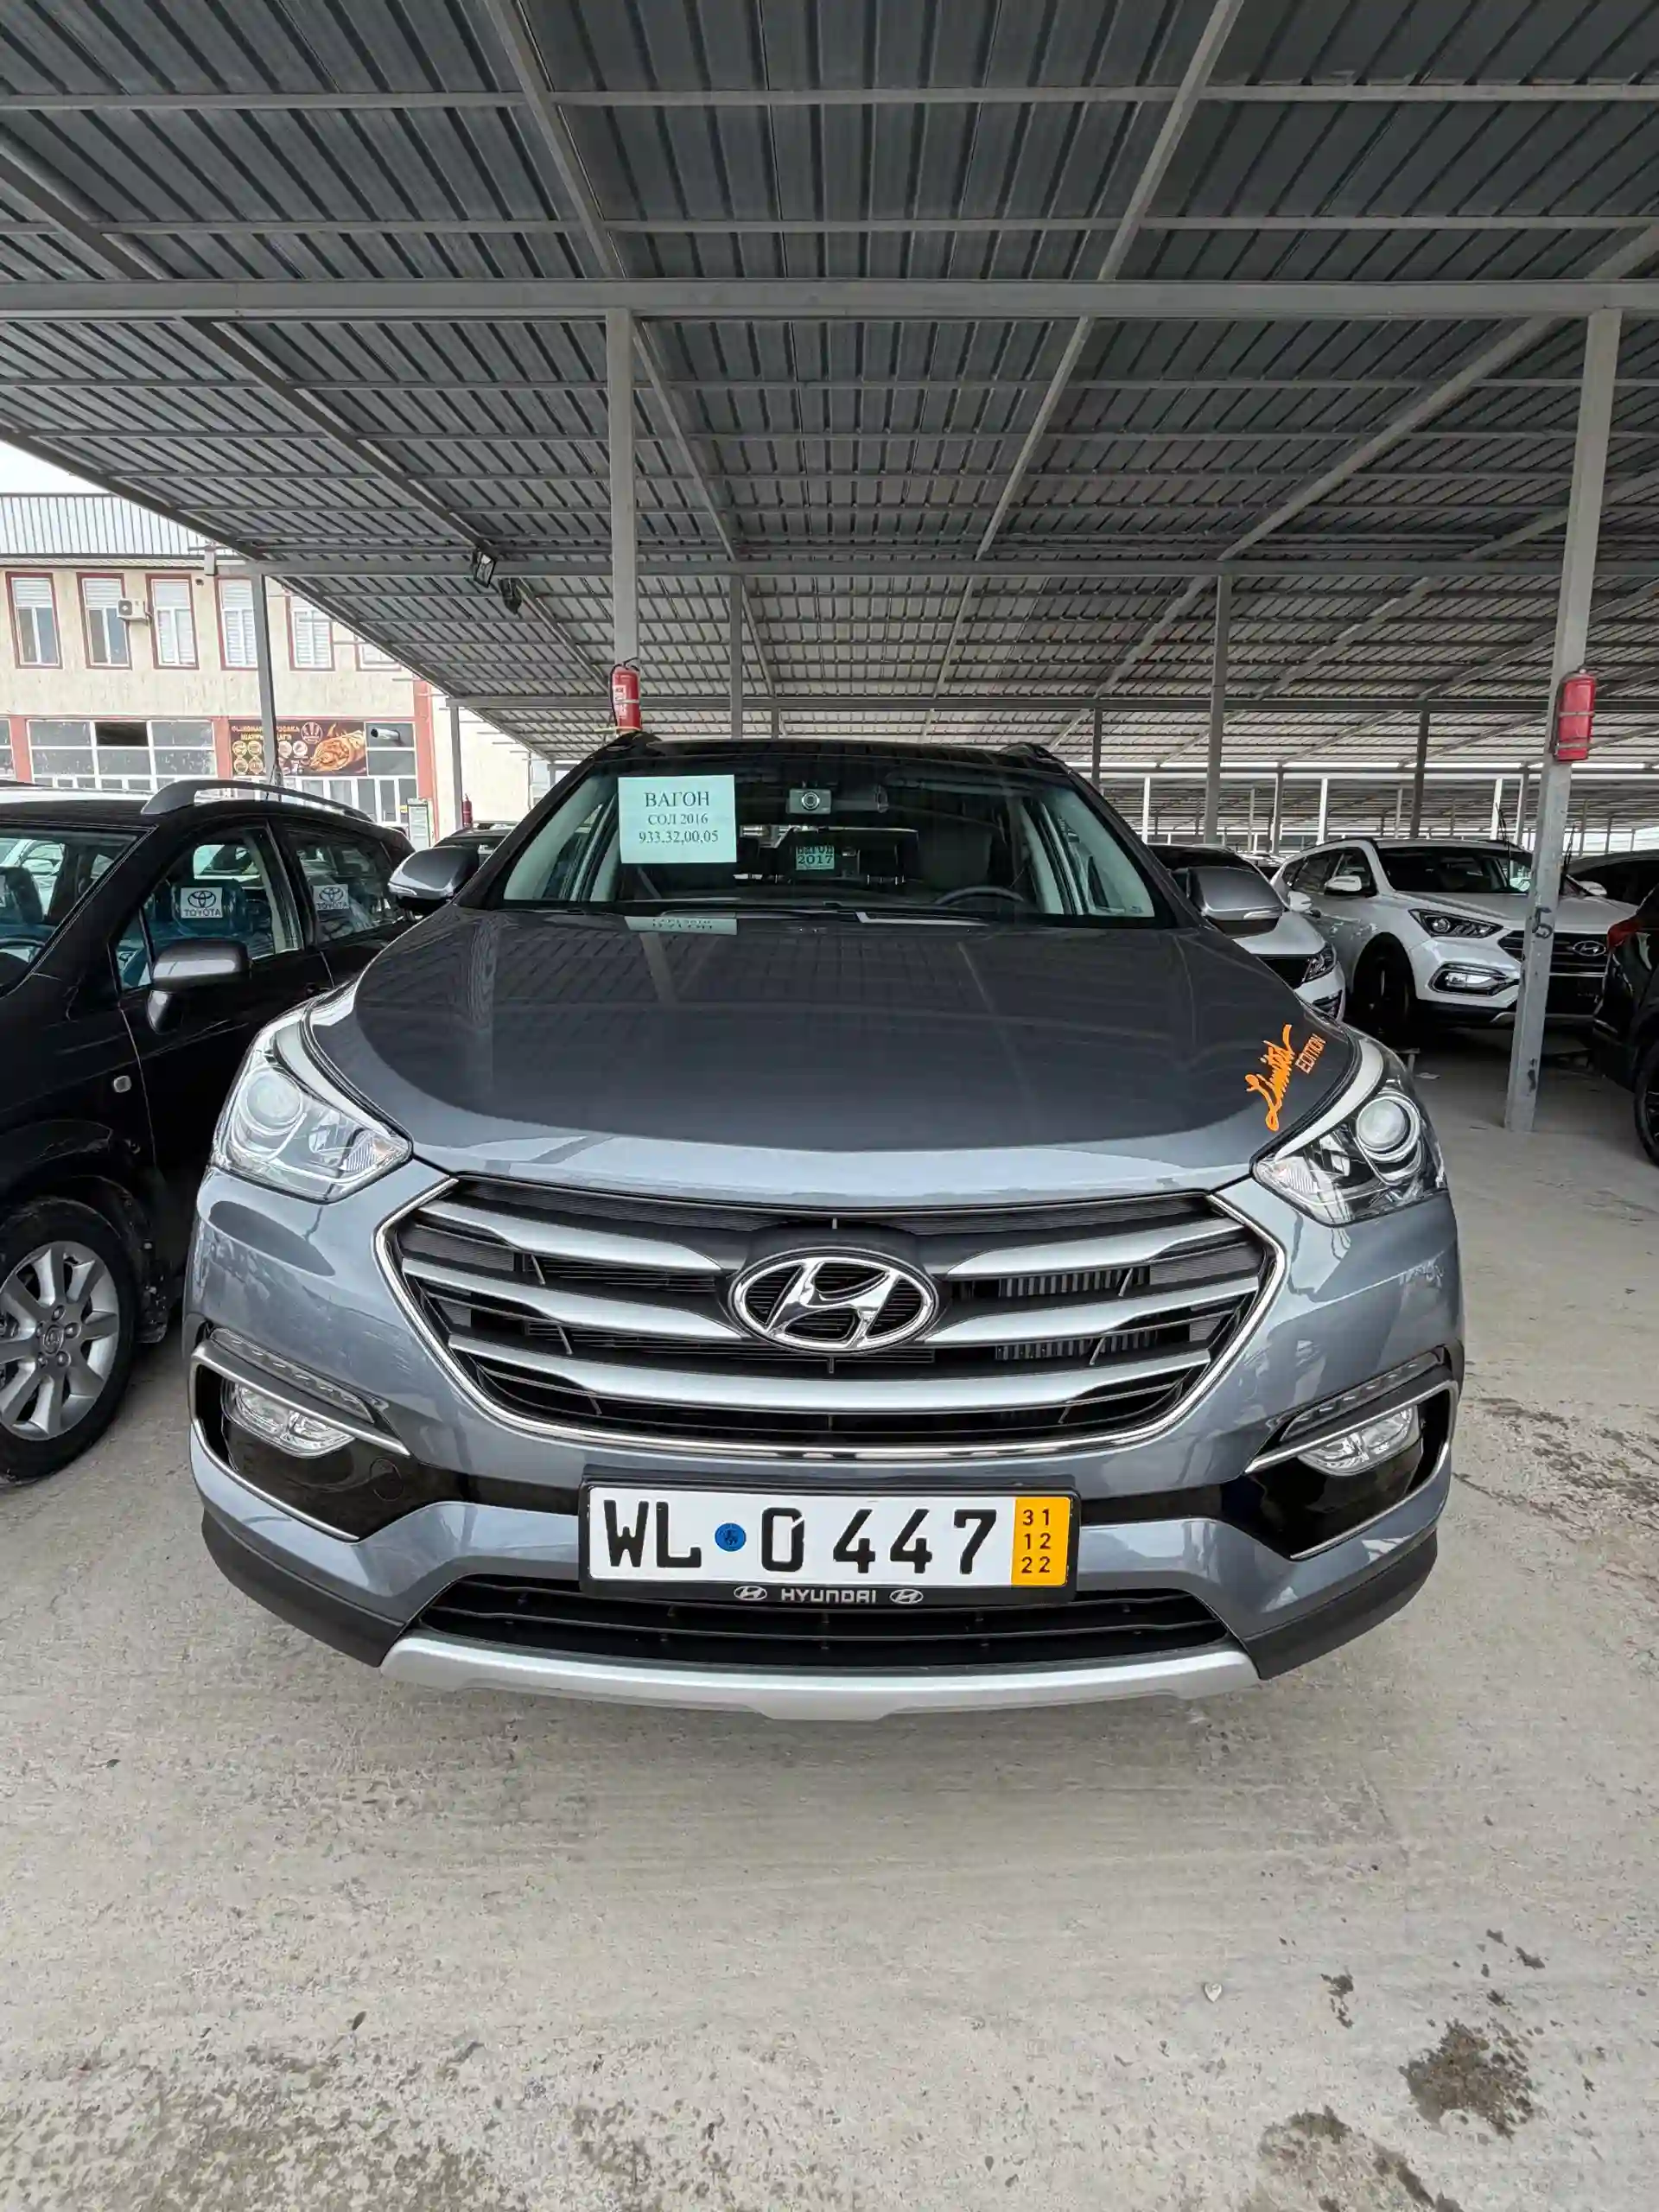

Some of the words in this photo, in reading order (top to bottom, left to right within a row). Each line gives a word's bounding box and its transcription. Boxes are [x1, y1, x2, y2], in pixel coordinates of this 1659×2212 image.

[645, 791, 709, 807] ВАГОН
[648, 814, 677, 825] СОЛ
[680, 813, 709, 824] 2016
[798, 855, 833, 864] 2017
[183, 908, 221, 917] TOYOTA
[316, 901, 350, 910] TOYOTA
[1295, 1033, 1326, 1074] EDITION
[1022, 1508, 1050, 1526] 31
[603, 1499, 702, 1568] WL
[1024, 1532, 1052, 1550] 12
[1021, 1556, 1051, 1573] 22
[781, 1588, 876, 1604] HYUNDAI
